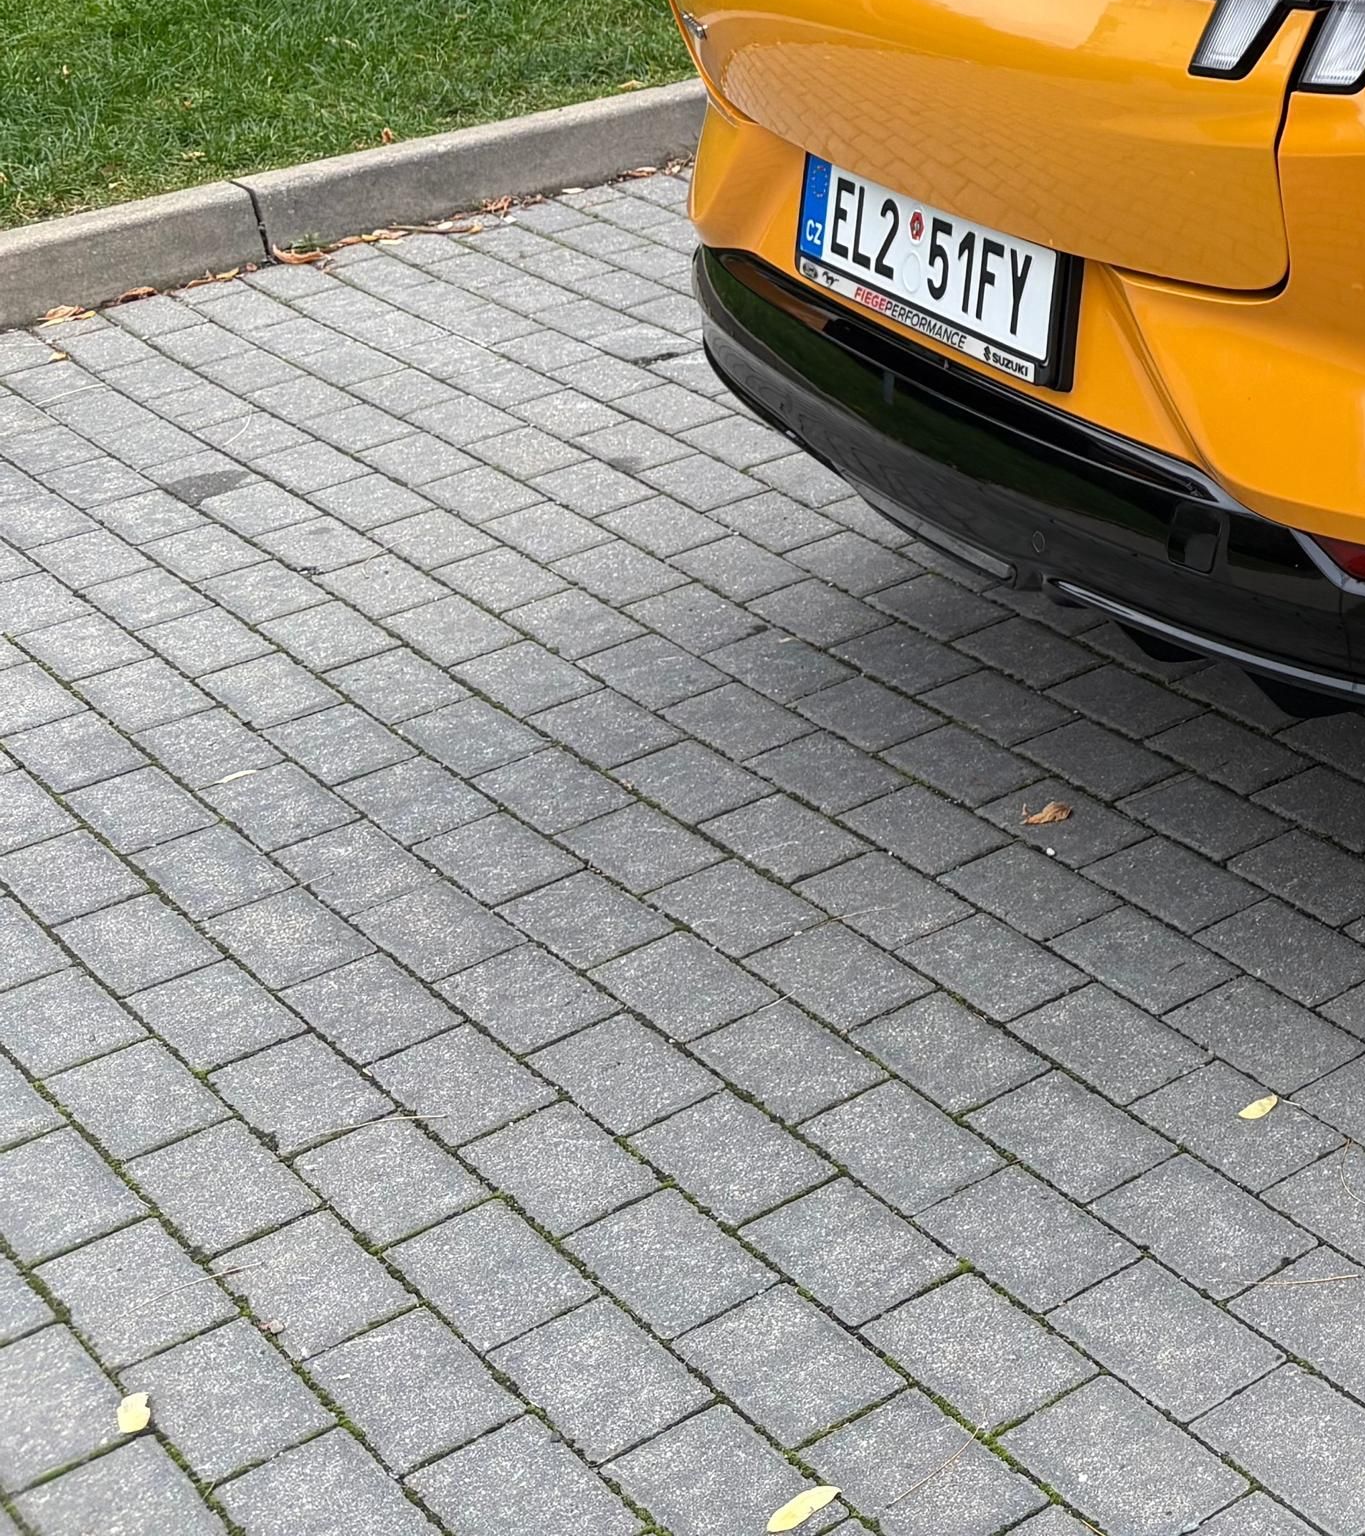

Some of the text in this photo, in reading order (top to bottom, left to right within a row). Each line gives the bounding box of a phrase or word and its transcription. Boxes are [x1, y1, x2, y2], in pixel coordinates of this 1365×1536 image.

[806, 219, 823, 246] CZ
[830, 177, 1033, 336] EL2 51FY
[992, 352, 1028, 377] SUZUKI
